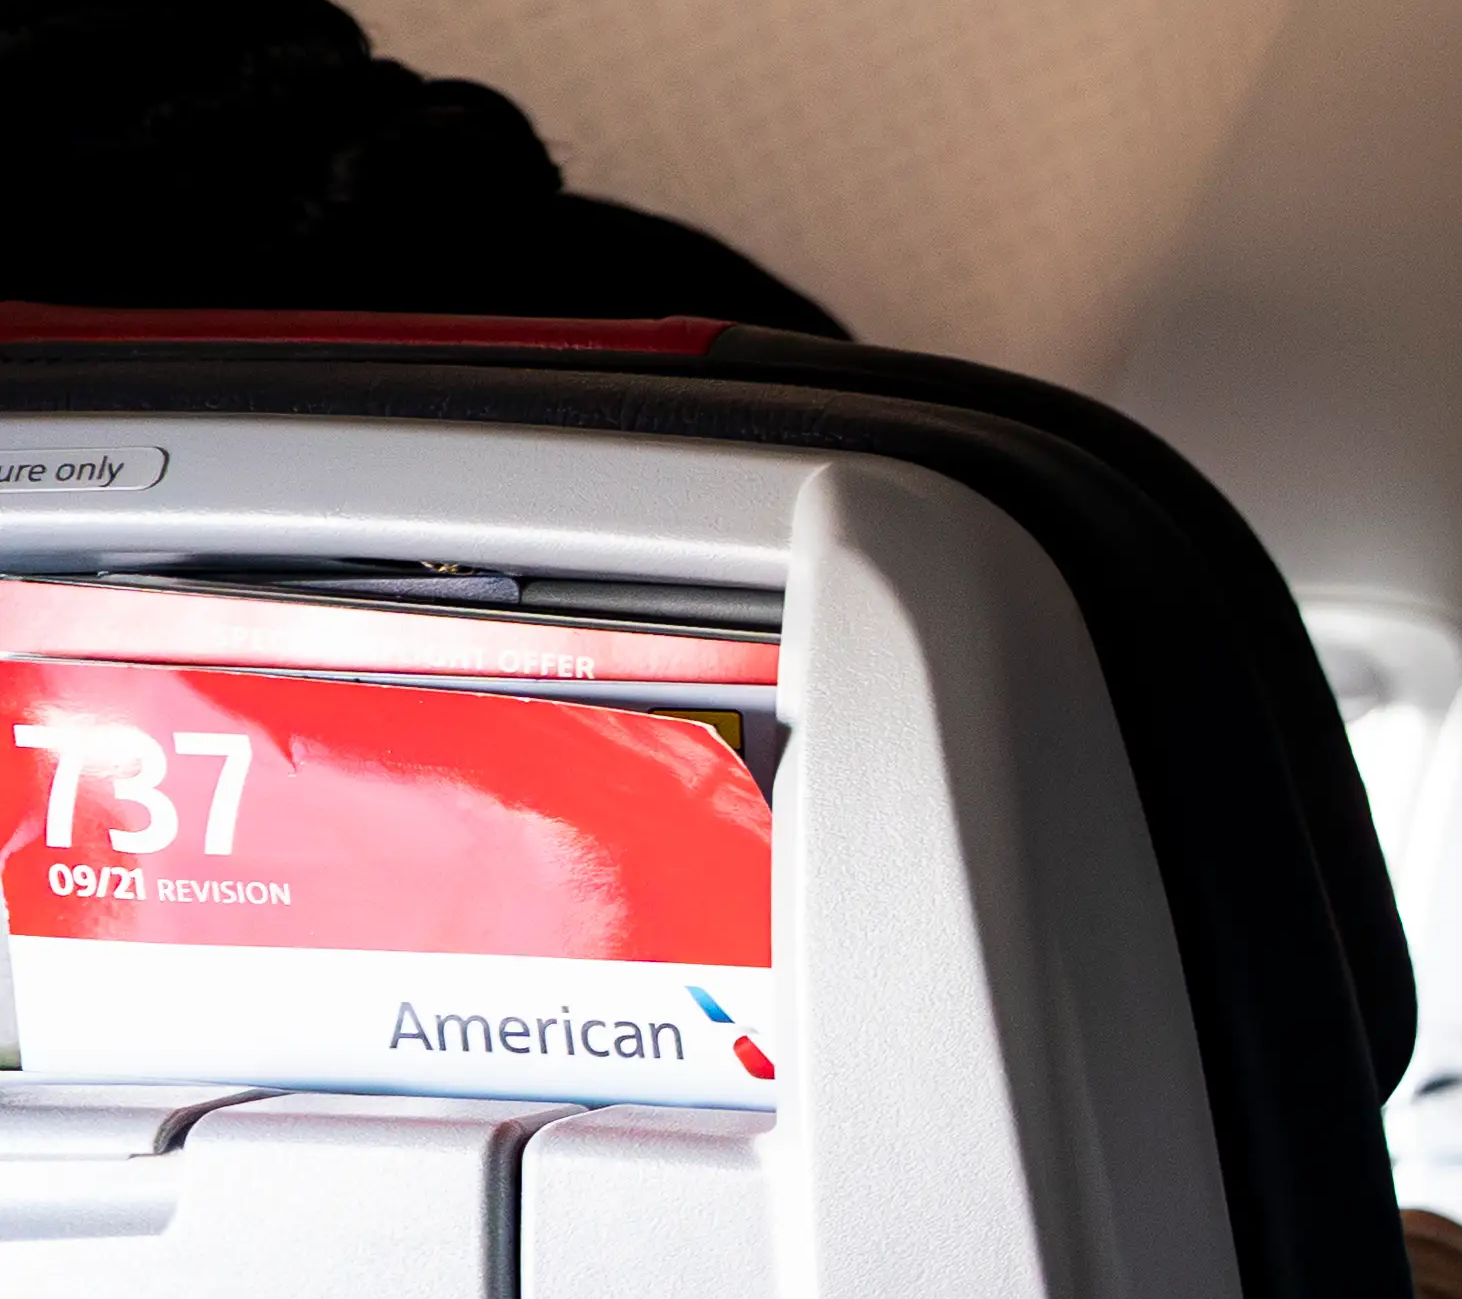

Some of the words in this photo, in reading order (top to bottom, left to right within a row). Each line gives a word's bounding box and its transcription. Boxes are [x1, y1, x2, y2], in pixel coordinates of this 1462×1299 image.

[55, 455, 125, 487] only
[498, 649, 595, 679] OFFER
[14, 722, 253, 857] 737
[47, 863, 147, 903] 09/21
[156, 877, 292, 908] REVISION
[389, 1000, 686, 1062] American
